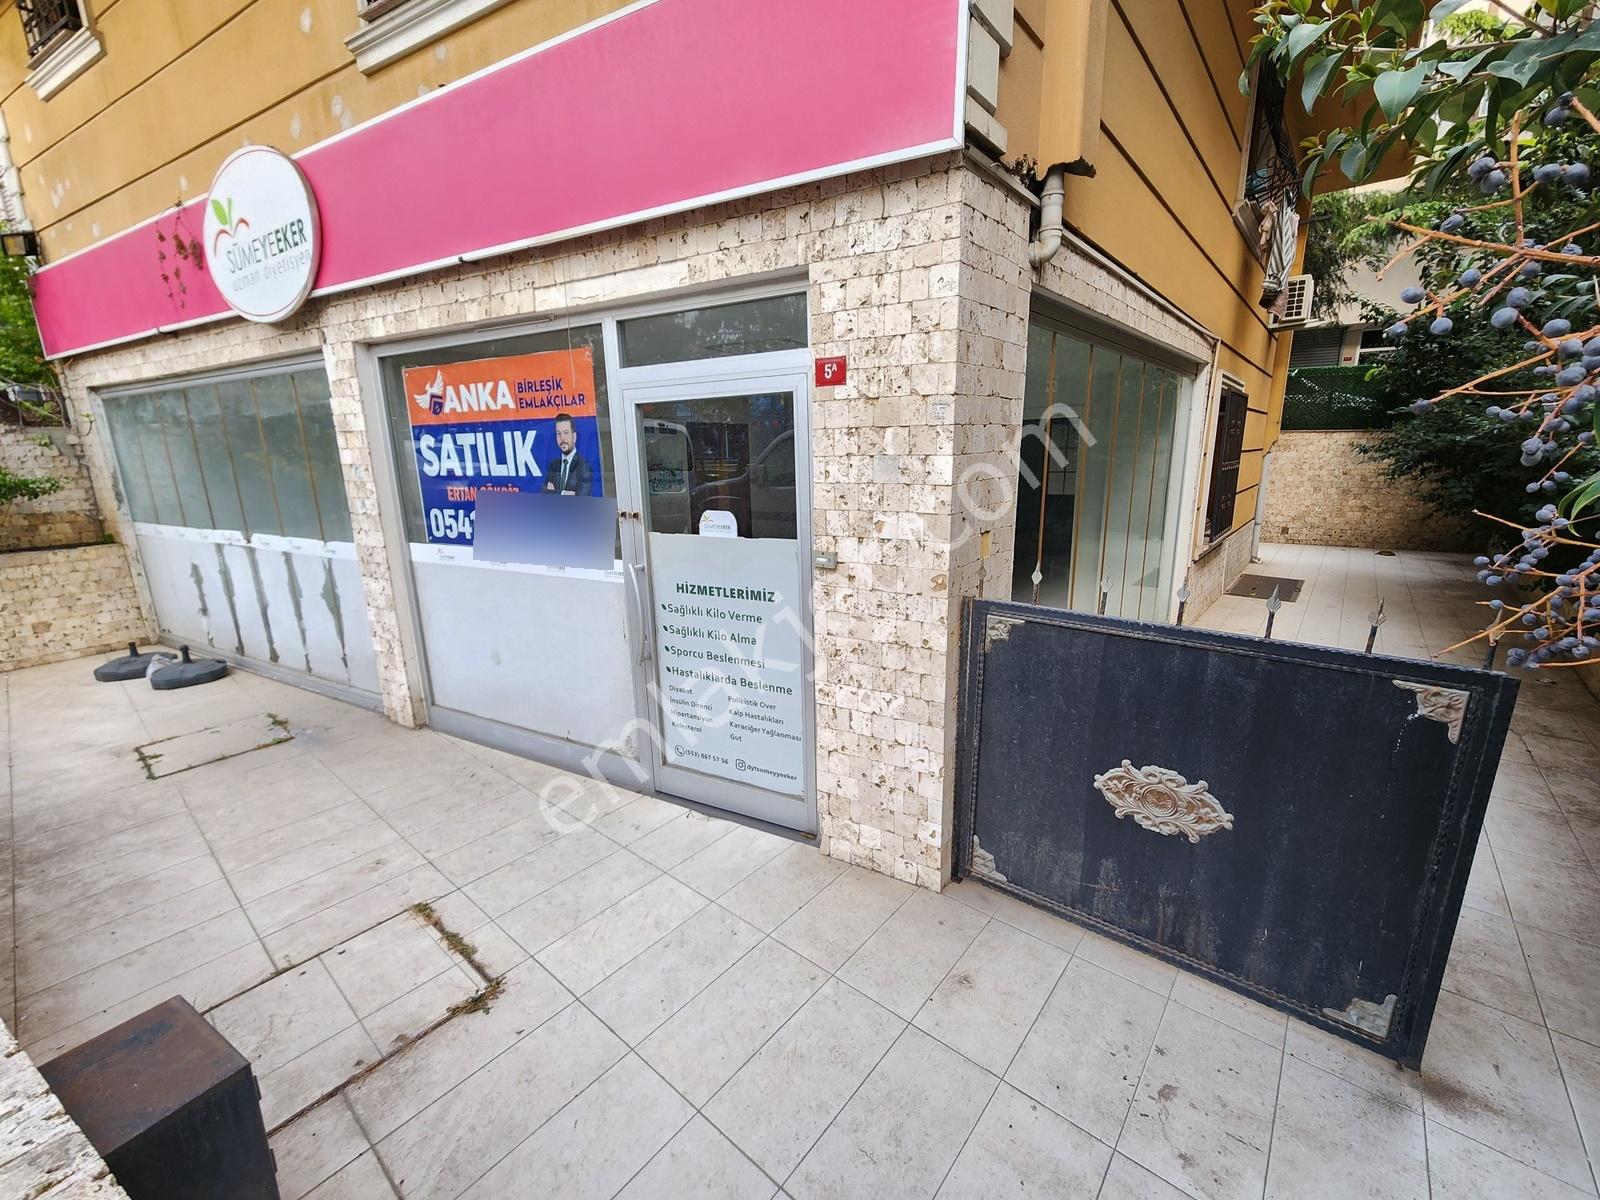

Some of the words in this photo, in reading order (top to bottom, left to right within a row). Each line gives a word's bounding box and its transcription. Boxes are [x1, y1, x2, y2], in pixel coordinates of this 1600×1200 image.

[264, 250, 310, 280] diyetisyen
[517, 376, 563, 395] BİRLEŞİK
[444, 380, 515, 413] ANKA
[519, 393, 585, 411] EMLAKÇILAR
[420, 430, 542, 477] SATILIK
[447, 486, 477, 501] ERTAN
[676, 581, 776, 602] HİZMETLERİMİZ
[667, 604, 703, 617] Sağlıklı
[706, 608, 726, 619] Kilo
[728, 610, 763, 623] Verme
[669, 625, 704, 638] Sağlıklı
[707, 629, 727, 641] Kilo
[730, 633, 757, 645] Alma
[670, 645, 704, 658] Sporcu
[706, 651, 765, 669] Beslenmesi
[672, 666, 737, 685] Hastalıklarda
[740, 677, 793, 695] Beslenme
[729, 709, 743, 717] Kalp
[760, 702, 776, 710] Over
[729, 721, 760, 733] Karaciğer
